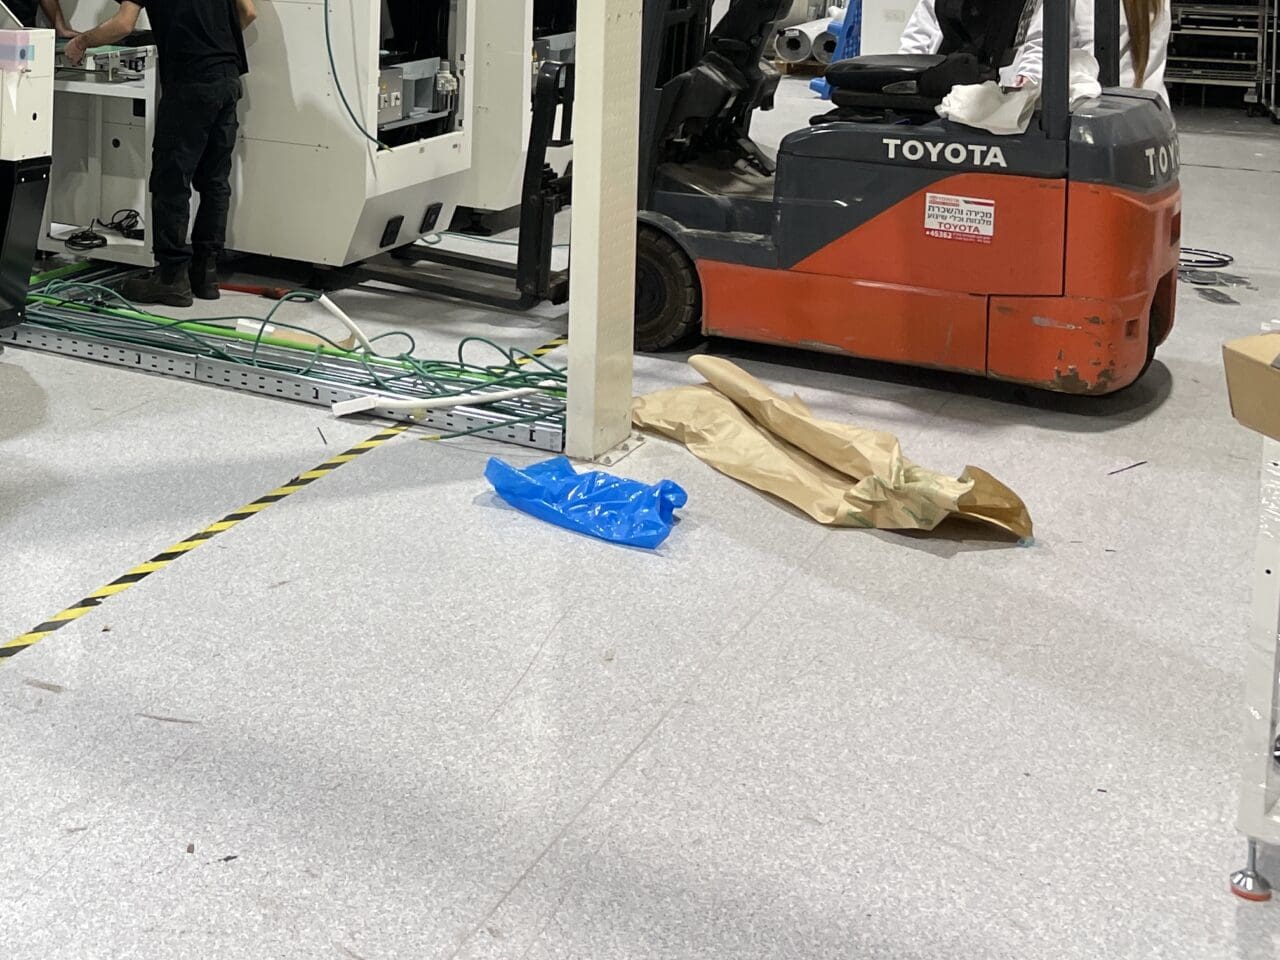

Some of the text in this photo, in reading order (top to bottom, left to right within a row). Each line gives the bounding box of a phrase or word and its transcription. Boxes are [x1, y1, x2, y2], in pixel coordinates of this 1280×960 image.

[882, 138, 1008, 167] TOYOTA
[1145, 141, 1179, 175] TOY
[928, 205, 992, 219] מכירה והשכרת
[928, 212, 992, 226] מלגזות וכלי שינוע
[938, 222, 980, 233] TOYOTA
